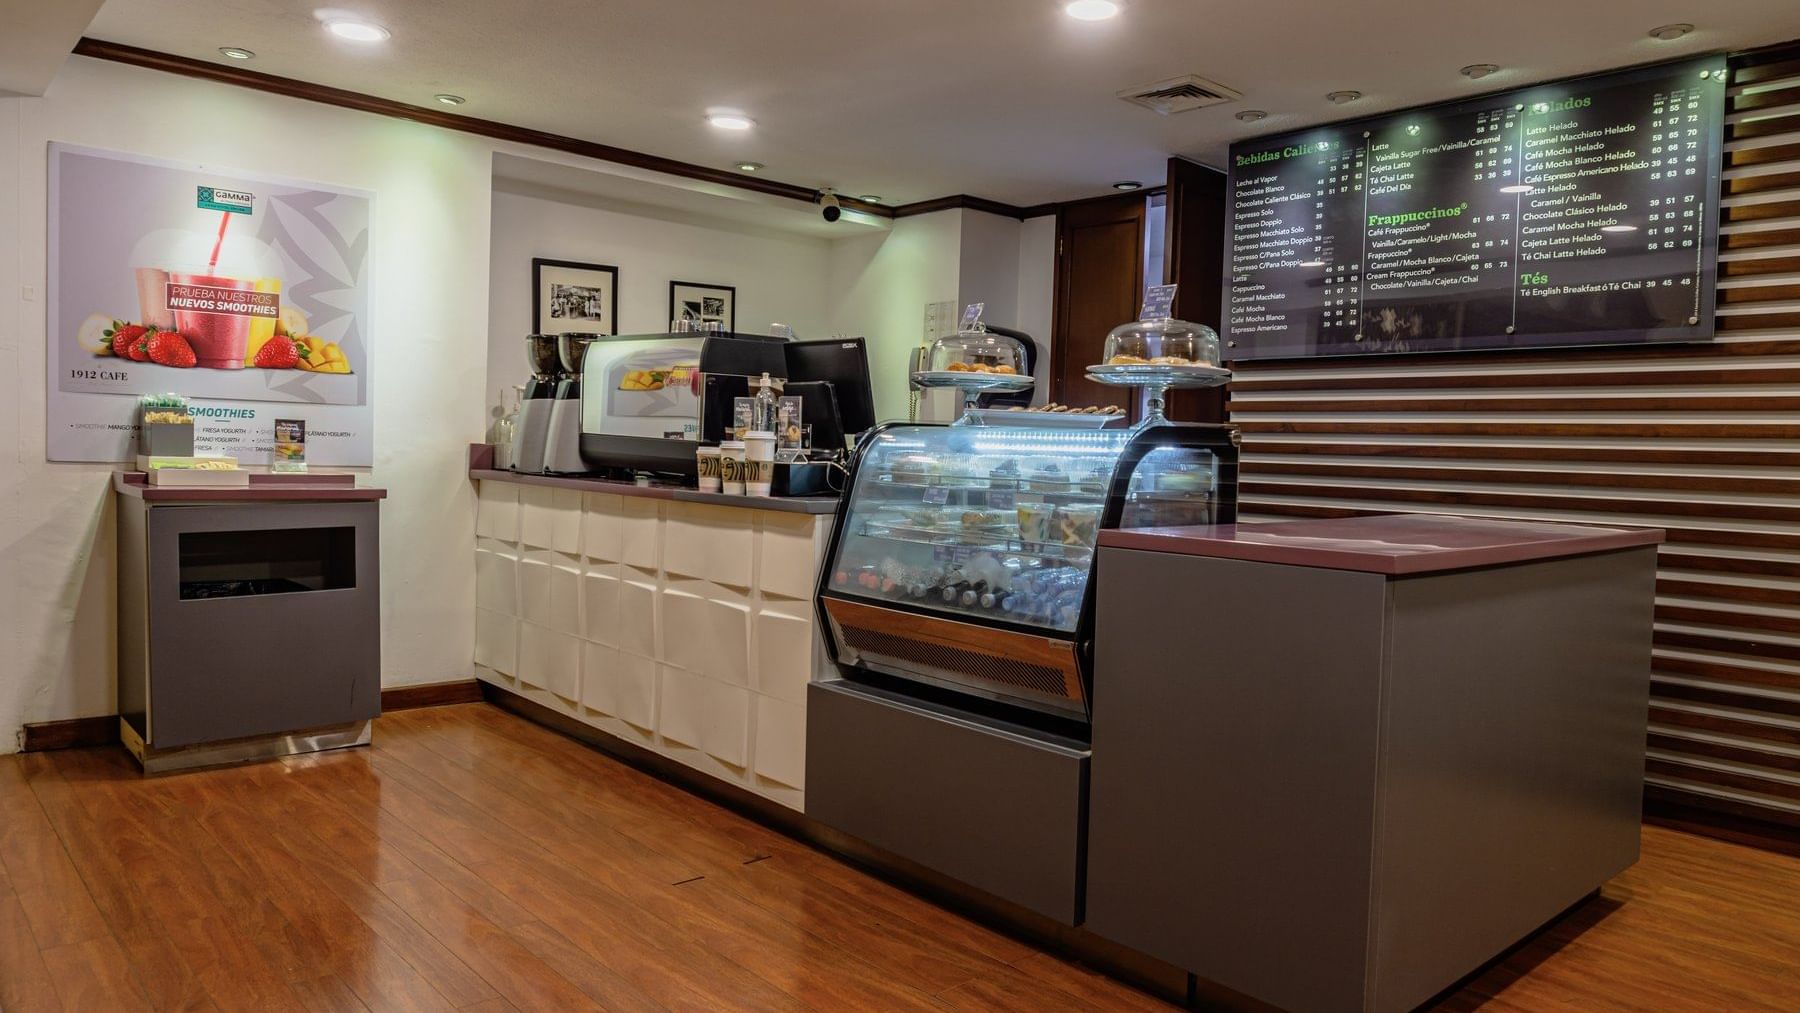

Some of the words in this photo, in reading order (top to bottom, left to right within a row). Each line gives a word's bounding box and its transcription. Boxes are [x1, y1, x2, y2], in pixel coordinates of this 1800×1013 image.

[1528, 97, 1591, 116] lados
[1688, 101, 1697, 109] 60
[1526, 125, 1546, 135] Latte
[1549, 120, 1578, 132] Helado
[1669, 117, 1679, 125] 67
[1525, 136, 1558, 148] Caramel
[1560, 129, 1602, 143] Macchiato
[1605, 124, 1636, 137] Helado
[1372, 143, 1389, 151] Latte
[1525, 149, 1544, 161] Café
[1546, 146, 1572, 157] Mocha
[1575, 142, 1605, 153] Helado
[1236, 150, 1280, 166] Bebidas
[1376, 152, 1399, 162] Vainilla
[1401, 149, 1420, 160] Sugar
[1525, 162, 1543, 173] Café
[1545, 157, 1572, 168] Mocha
[1575, 154, 1602, 165] Blanco
[1605, 150, 1635, 161] Helado
[1371, 164, 1391, 174] Cajeta
[1393, 161, 1411, 170] Latte
[1525, 173, 1542, 184] Café
[1543, 169, 1575, 182] Espresso
[1577, 164, 1618, 176] Americano
[1620, 160, 1649, 172] Helado
[1236, 179, 1252, 187] Leche
[1260, 175, 1278, 185] Vapor
[1370, 175, 1379, 184] Té
[1381, 174, 1395, 183] Chai
[1397, 171, 1414, 181] Latte
[1236, 188, 1264, 198] Chocolate
[1265, 185, 1285, 194] Blanco
[1370, 185, 1385, 195] Café
[1387, 183, 1398, 193] Del
[1400, 183, 1411, 192] Día
[1548, 183, 1577, 193] Helado
[1235, 199, 1263, 209] Chocolate
[1264, 195, 1289, 204] Caliente
[1290, 192, 1311, 201] Clásico
[1531, 197, 1564, 208] Caramel
[1572, 193, 1602, 204] Vainilla
[1235, 212, 1260, 221] Espresso
[1261, 209, 1274, 217] Solo
[1523, 210, 1563, 221] Chocolate
[1565, 206, 1594, 217] Clásico
[1597, 202, 1627, 213] Helado
[1235, 222, 1259, 231] Espresso
[1261, 218, 1282, 228] Doppio
[1522, 224, 1555, 234] Caramel
[1558, 220, 1585, 231] Mocha
[1587, 217, 1617, 228] Helado
[1235, 232, 1259, 241] Espresso
[1260, 228, 1289, 237] Macchiato
[1291, 226, 1304, 234] Solo
[1368, 228, 1384, 237] Café
[1234, 243, 1258, 252] Espresso
[1260, 239, 1289, 248] Macchiato
[1290, 236, 1313, 246] Doppio
[1522, 238, 1547, 249] Cajeta
[1550, 235, 1570, 245] Latte
[1572, 231, 1602, 242] Helado
[1234, 254, 1258, 263] Espresso
[1260, 250, 1280, 259] C/Pana
[1281, 249, 1294, 257] Solo
[1521, 251, 1532, 260] Té
[1534, 248, 1550, 259] Chai
[1553, 248, 1574, 257] Latte
[1576, 245, 1606, 255] Helado
[1233, 264, 1258, 274] Espresso
[1259, 261, 1279, 269] C/Pana
[1367, 272, 1388, 281] Cream
[1520, 272, 1548, 285] Tés
[1232, 284, 1265, 294] Cappuccino
[1520, 286, 1530, 296] Té
[1533, 285, 1560, 297] English
[1563, 283, 1600, 294] Breakfast
[1610, 281, 1619, 290] Té
[1622, 280, 1641, 289] Chai
[172, 286, 216, 299] PRUEBA
[217, 290, 272, 305] NUESTROS
[1232, 295, 1255, 303] Caramel
[1256, 293, 1286, 301] Macchiato
[170, 297, 215, 310] NUEVOS
[216, 302, 277, 315] SMOOTHIES
[1232, 305, 1244, 314] Café
[1246, 304, 1265, 312] Mocha
[1231, 315, 1244, 324] Café
[1246, 313, 1264, 322] Mocha
[1266, 313, 1285, 321] Blanco
[1231, 325, 1256, 334] Espresso
[1257, 323, 1288, 332] Americano
[71, 369, 97, 379] 1912
[100, 371, 128, 381] CAFE
[187, 406, 256, 419] SMOOTHIES
